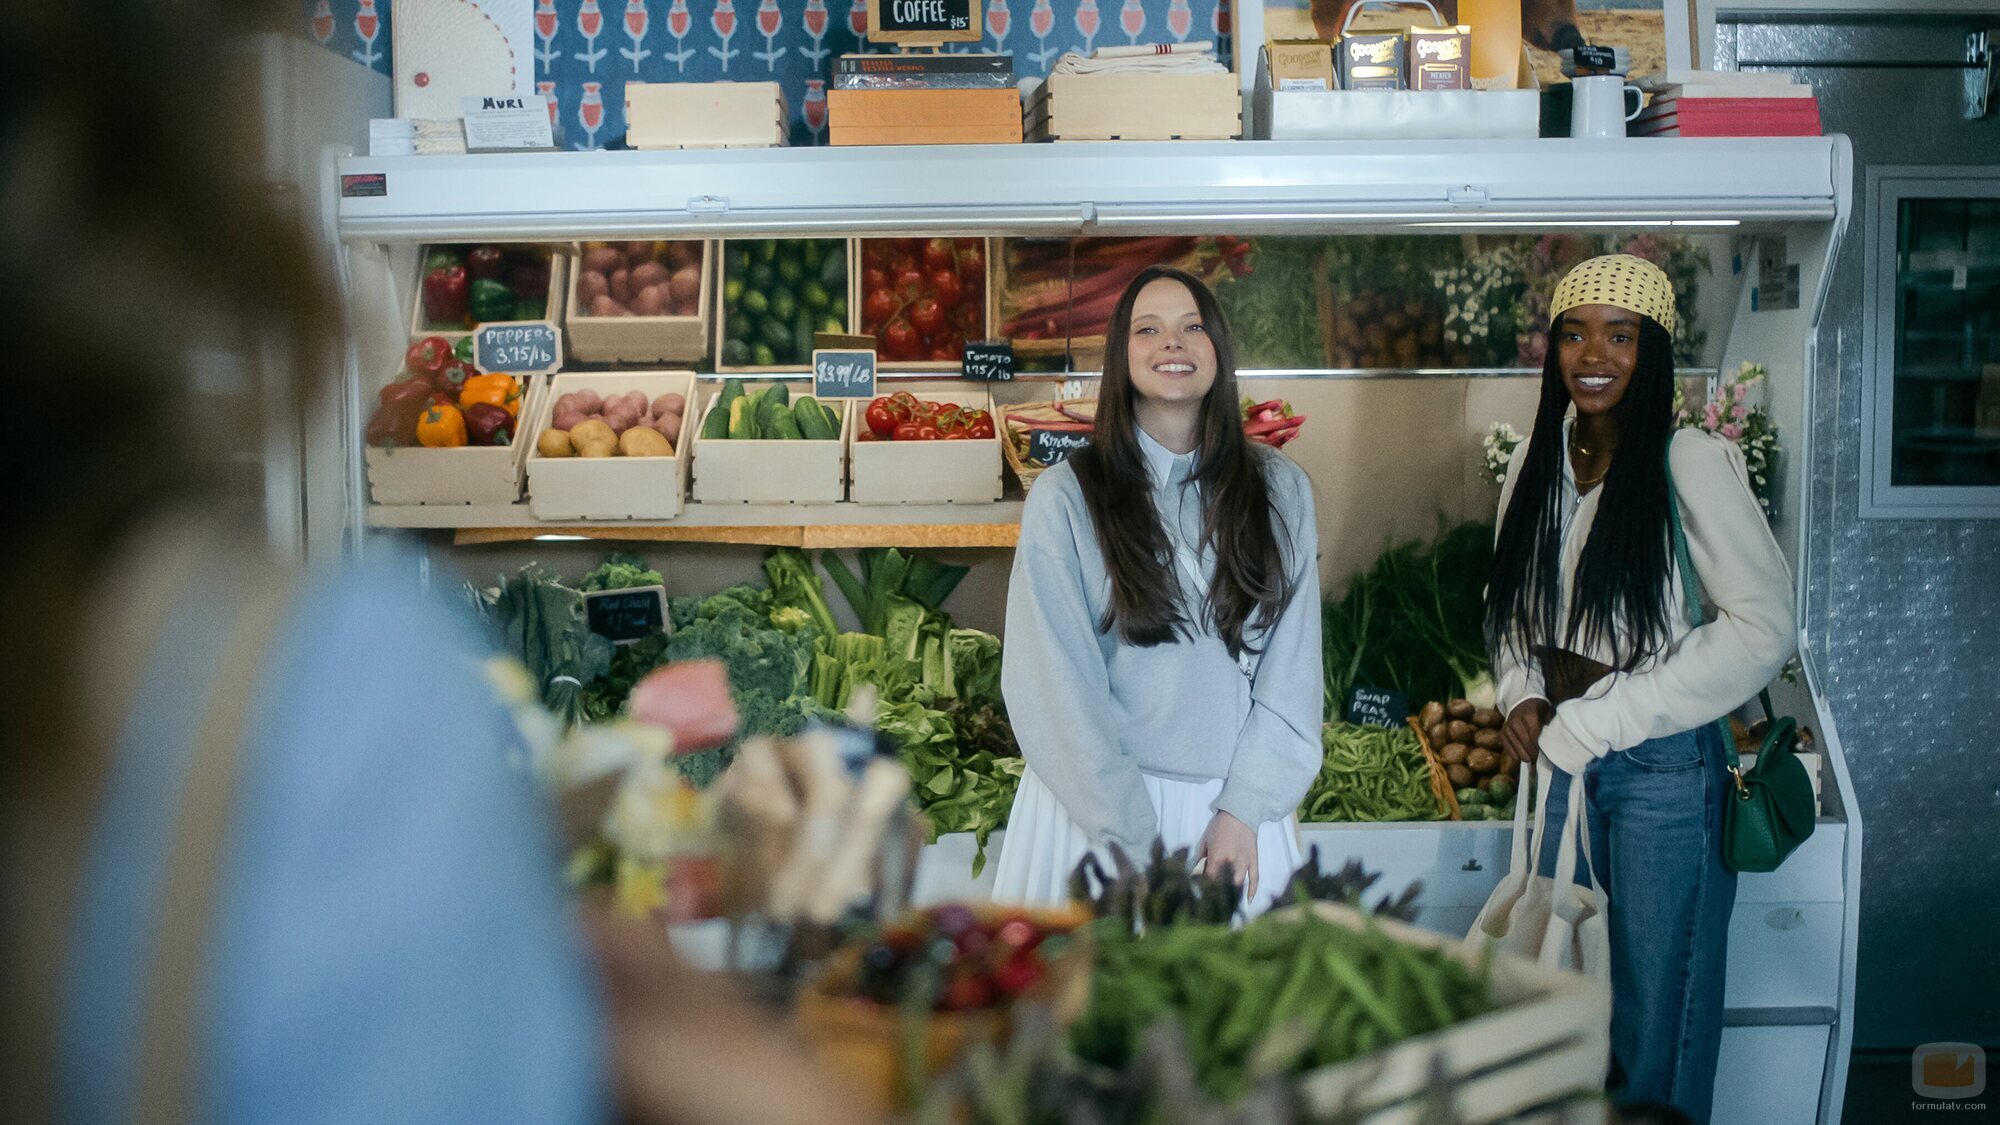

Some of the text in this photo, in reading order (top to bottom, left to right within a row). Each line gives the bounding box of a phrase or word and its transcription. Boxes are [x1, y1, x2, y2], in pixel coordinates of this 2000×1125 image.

[893, 0, 947, 23] COFFEE
[482, 97, 524, 110] MURI
[486, 328, 554, 344] PEPPERS
[1353, 701, 1388, 719] PEAS
